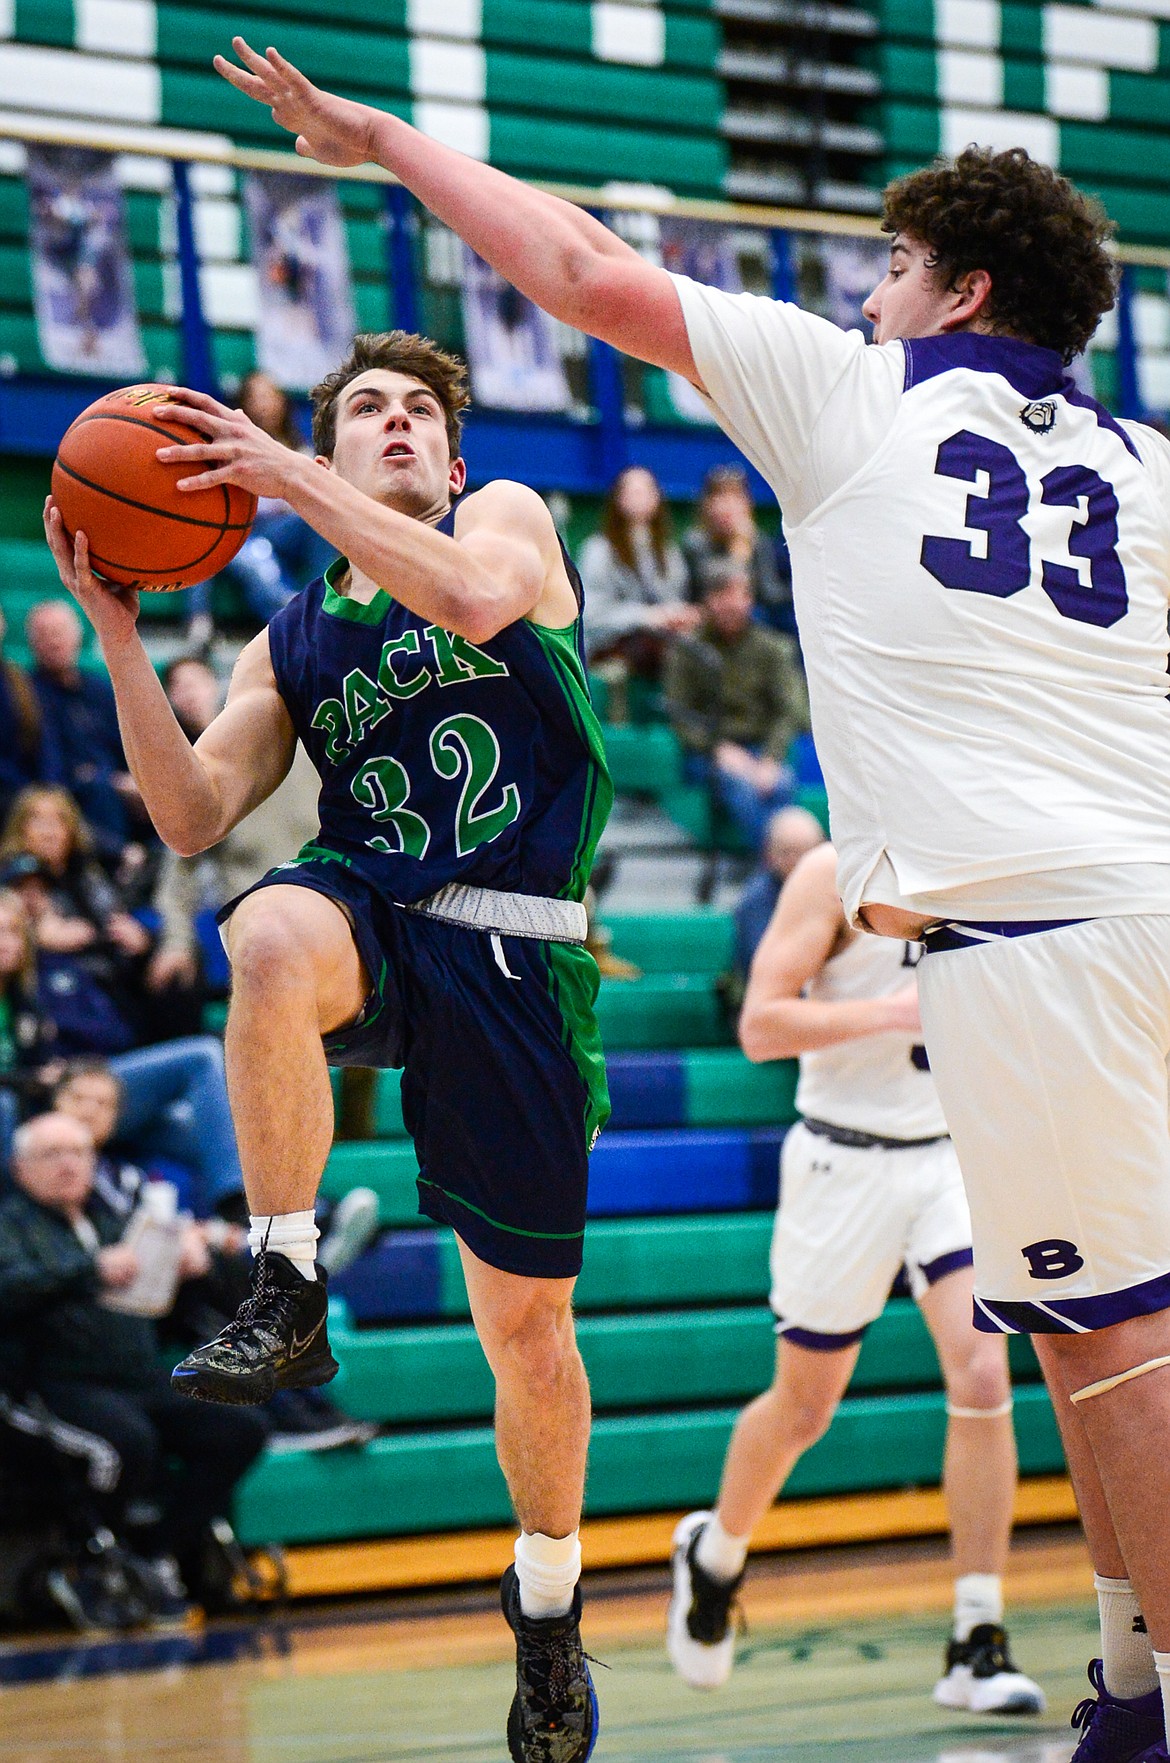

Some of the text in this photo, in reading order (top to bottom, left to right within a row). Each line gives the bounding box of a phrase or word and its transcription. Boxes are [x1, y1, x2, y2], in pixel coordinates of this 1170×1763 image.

[920, 429, 1129, 629] 33
[310, 624, 510, 766] PACK
[350, 713, 521, 860] 32
[1021, 1239, 1084, 1279] B
